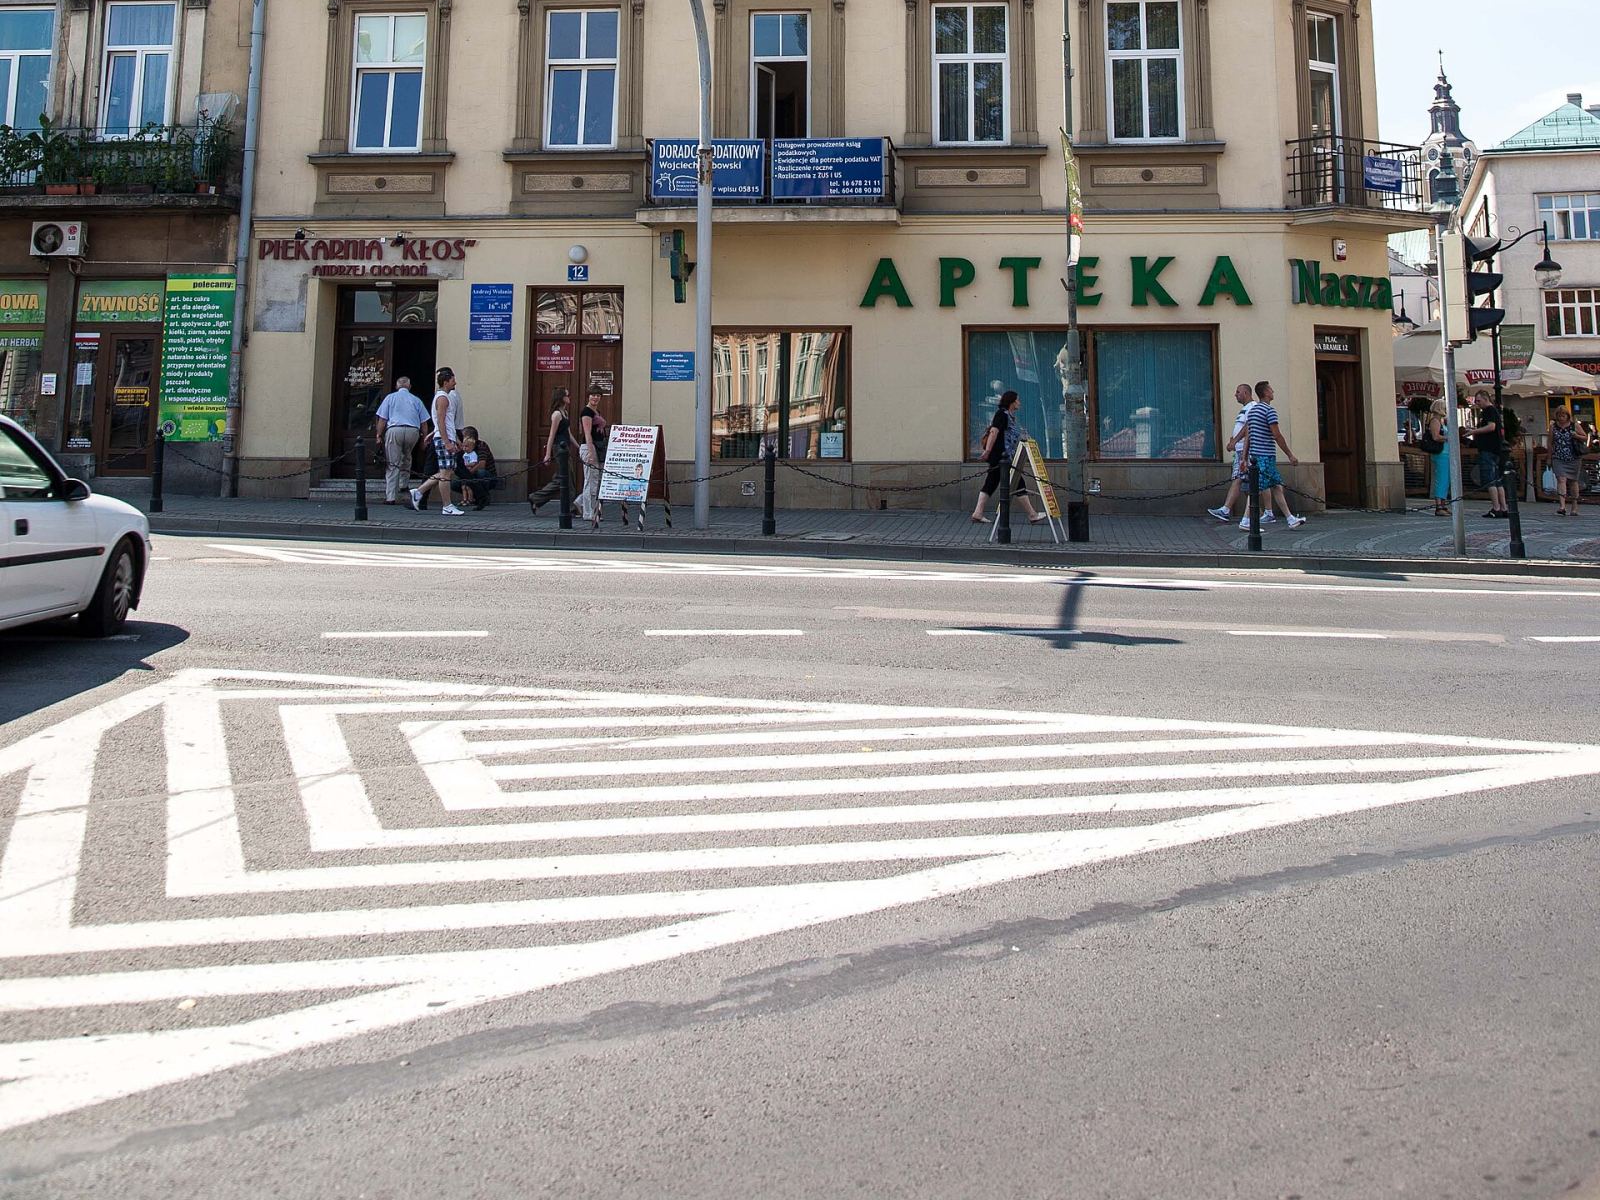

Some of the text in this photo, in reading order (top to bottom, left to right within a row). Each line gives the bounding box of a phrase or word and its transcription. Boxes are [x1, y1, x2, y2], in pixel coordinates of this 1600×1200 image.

[712, 144, 760, 159] ODATKOWY
[659, 161, 742, 170] Wojciech bowski
[258, 239, 383, 260] PIEKARNIA
[312, 262, 428, 277] ANDRZEJ CIOCHOŃ
[572, 265, 584, 278] 12
[192, 280, 234, 289] polecamy:
[859, 255, 1253, 308] APTEKA
[1288, 258, 1393, 310] Nasza
[0, 294, 39, 310] OWA
[81, 292, 161, 313] ŻYWNOŚĆ
[191, 312, 224, 320] wegetarian
[10, 338, 40, 347] HERBAT
[1471, 369, 1496, 380] ŻYWI
[168, 395, 211, 403] wspomagające
[212, 395, 228, 403] diety
